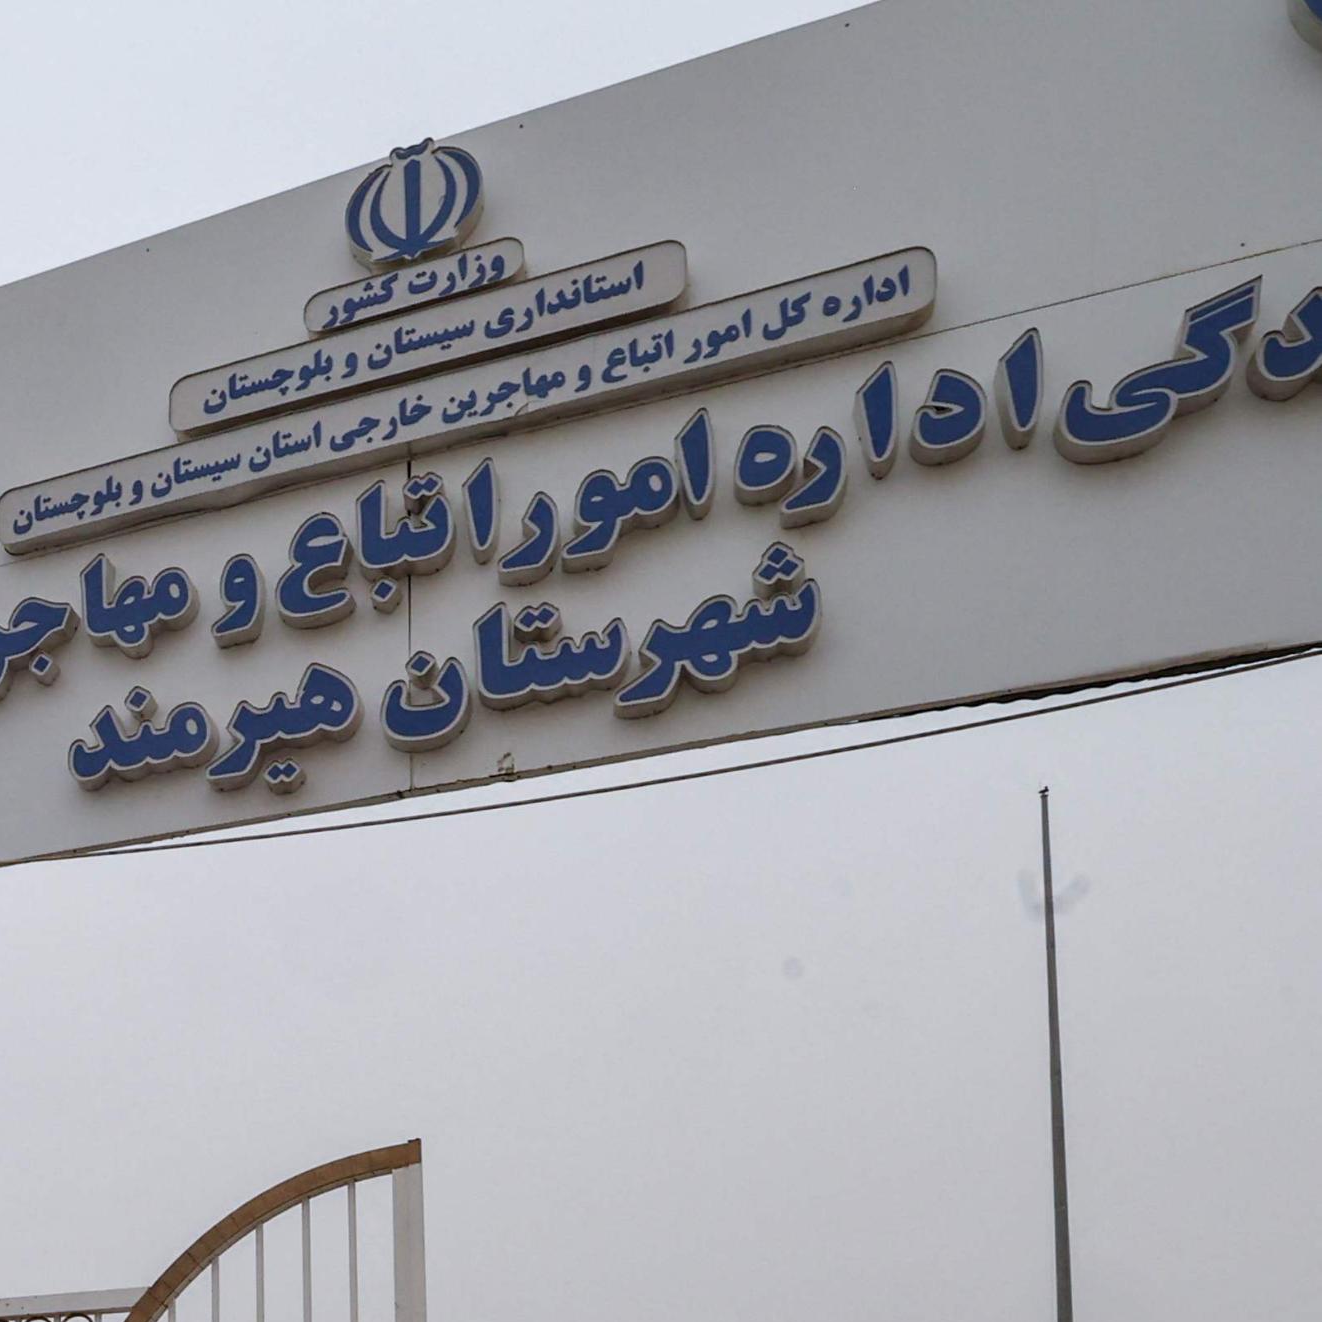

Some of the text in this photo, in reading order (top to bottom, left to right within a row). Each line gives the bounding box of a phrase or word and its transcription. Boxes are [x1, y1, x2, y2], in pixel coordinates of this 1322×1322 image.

[203, 260, 644, 414] استانداری سیستان و بلوچستان
[322, 253, 506, 329] وزارت کشور
[12, 266, 910, 535] اداره کل امور اتباع و مهاجرین خارجی استان سیستان و بلوچستان
[733, 328, 1045, 516] اداره
[273, 458, 500, 621] اتباع
[500, 408, 717, 580] امور
[68, 541, 822, 784] شهرستان هیرمند
[211, 552, 265, 640] و
